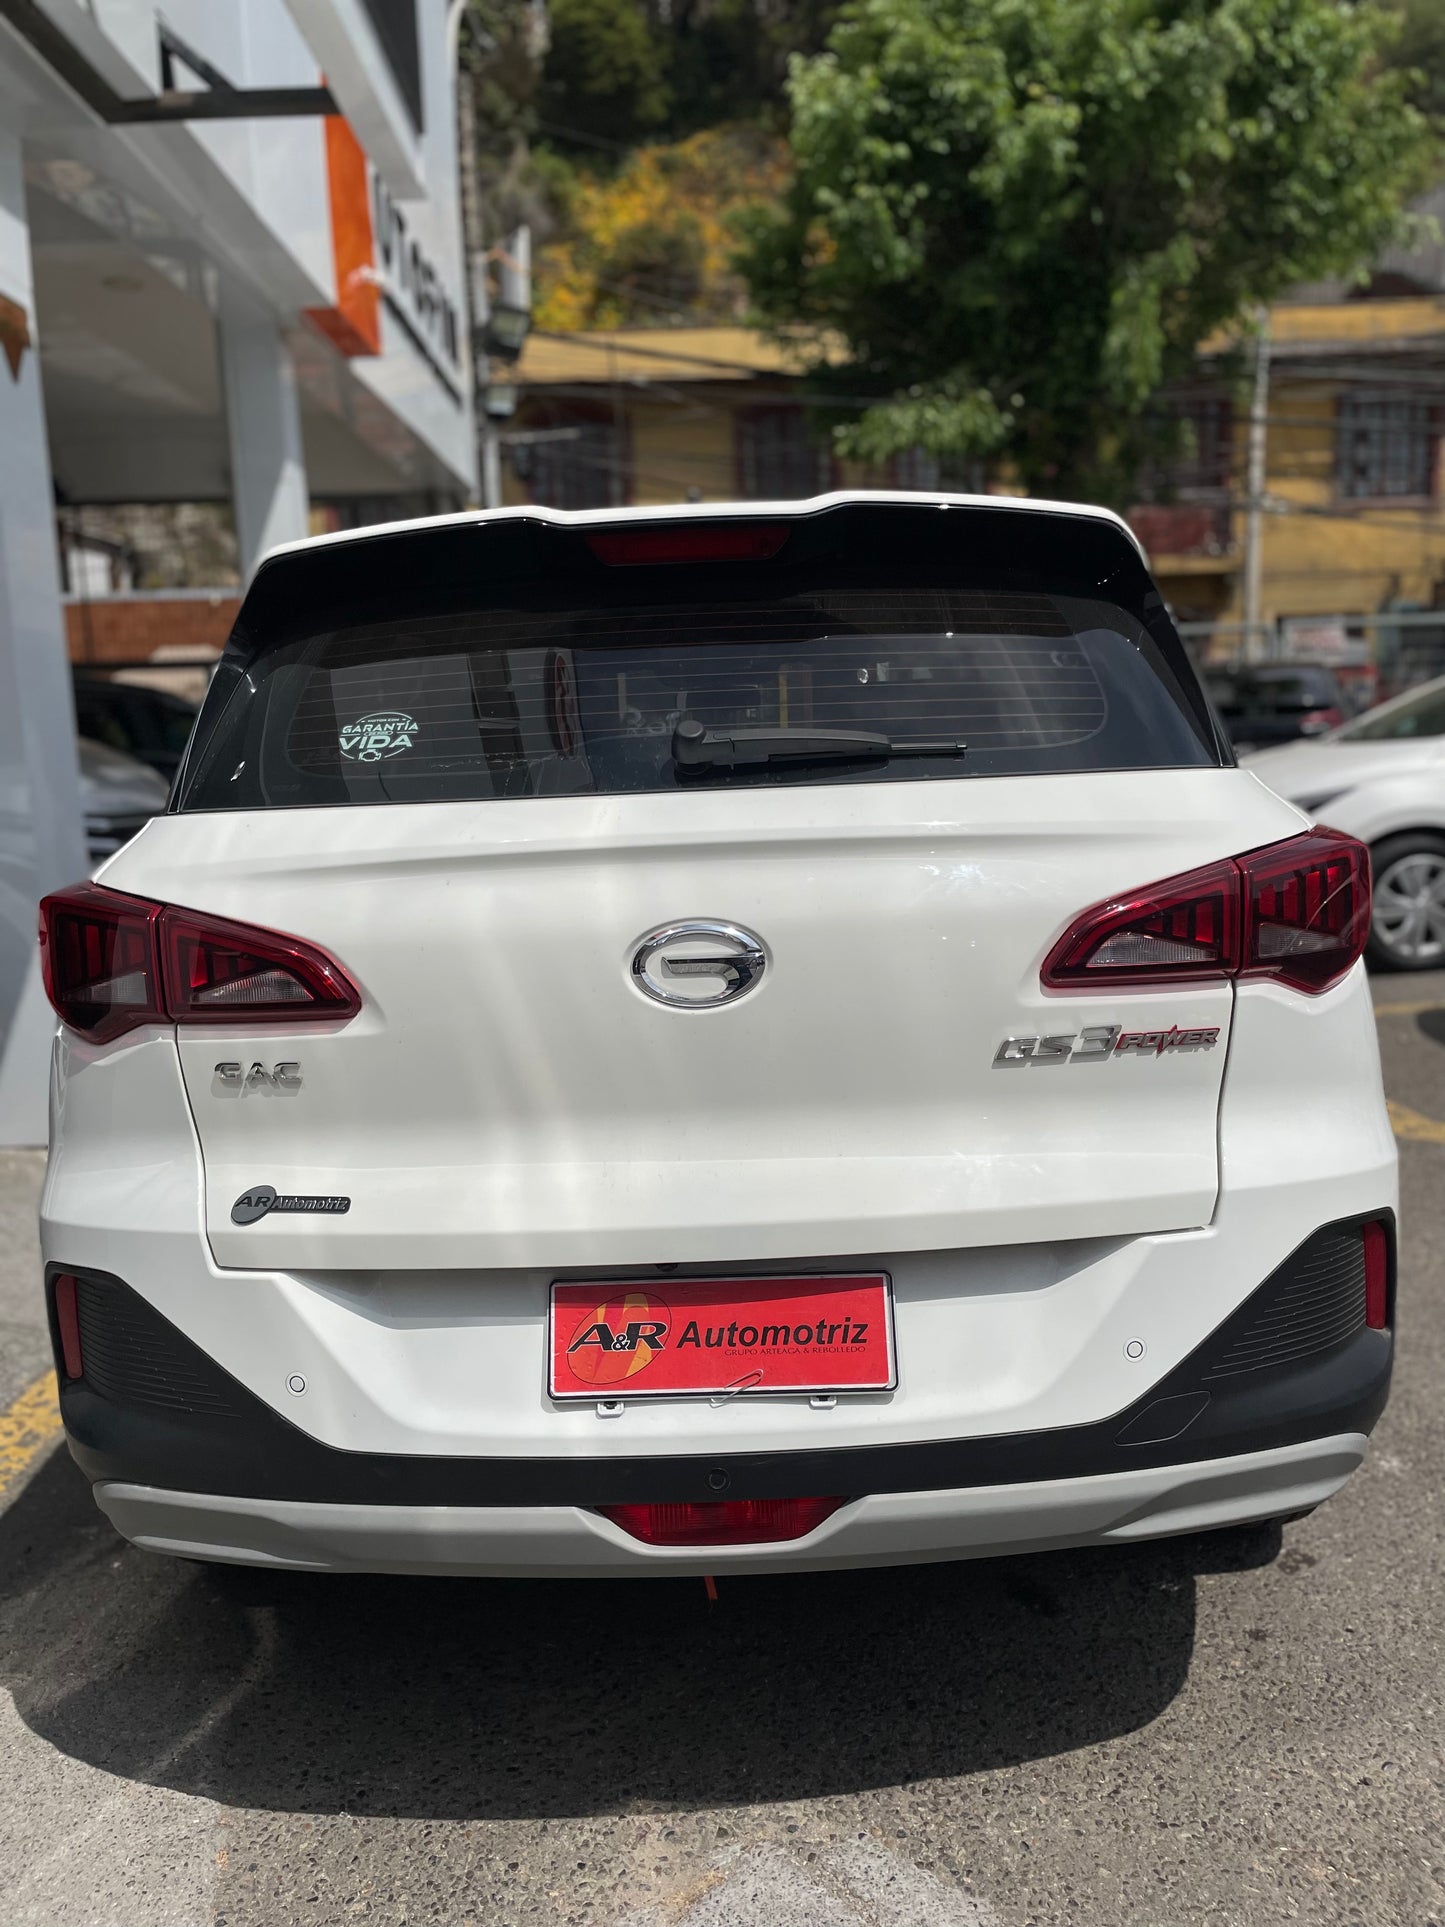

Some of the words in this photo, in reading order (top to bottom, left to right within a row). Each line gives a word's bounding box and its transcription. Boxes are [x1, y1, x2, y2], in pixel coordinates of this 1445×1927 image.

[342, 720, 419, 734] GARANTÍA
[339, 734, 413, 750] VIDA
[994, 1024, 1123, 1060] GS3
[1116, 1024, 1221, 1054] POWER
[214, 1061, 302, 1082] GAC
[235, 1196, 271, 1208] AR
[272, 1197, 347, 1210] Automotriz
[566, 1320, 668, 1354] A&R
[676, 1316, 868, 1349] Automotriz
[724, 1348, 758, 1357] GRUPO
[760, 1347, 801, 1355] ARTEAGA
[803, 1346, 810, 1354] &
[812, 1345, 866, 1354] REBOLLEDO
